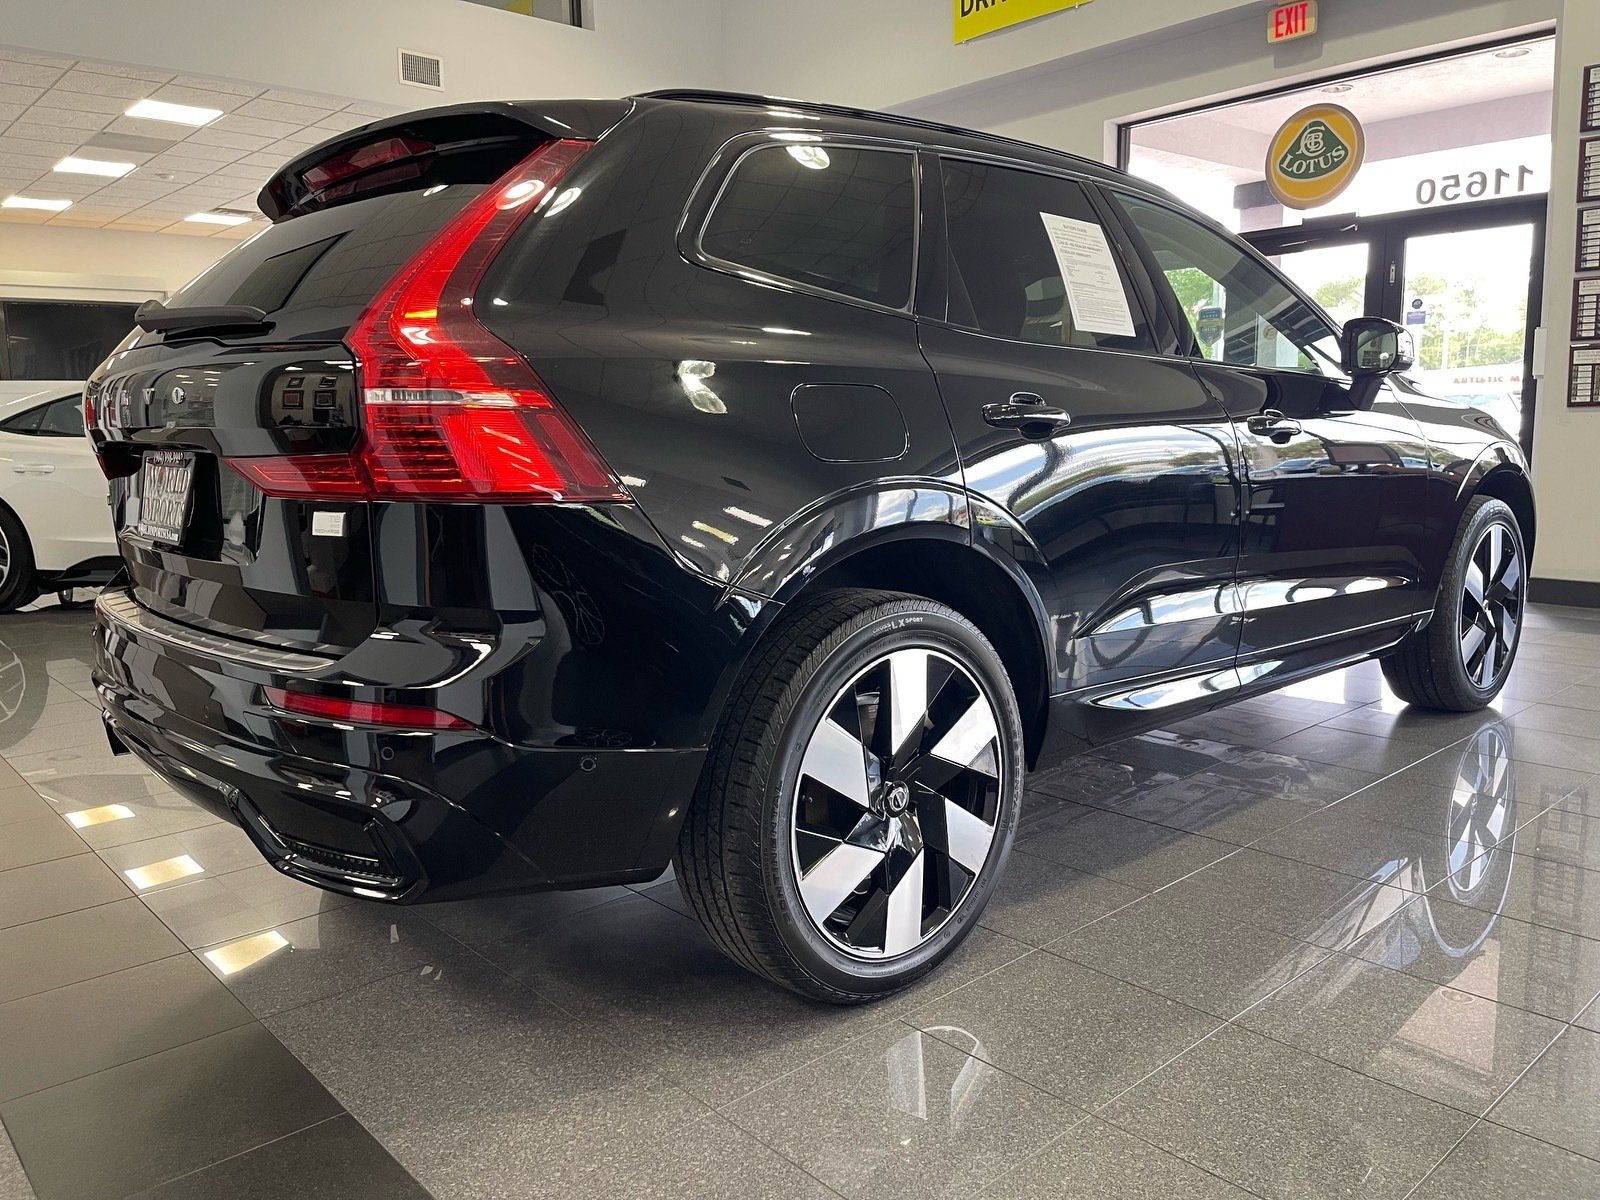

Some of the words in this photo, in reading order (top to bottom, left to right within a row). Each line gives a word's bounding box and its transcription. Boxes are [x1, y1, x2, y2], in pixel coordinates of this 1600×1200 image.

[1274, 3, 1308, 39] EXIT
[1281, 146, 1346, 175] LOTUS
[905, 616, 924, 624] SPORT
